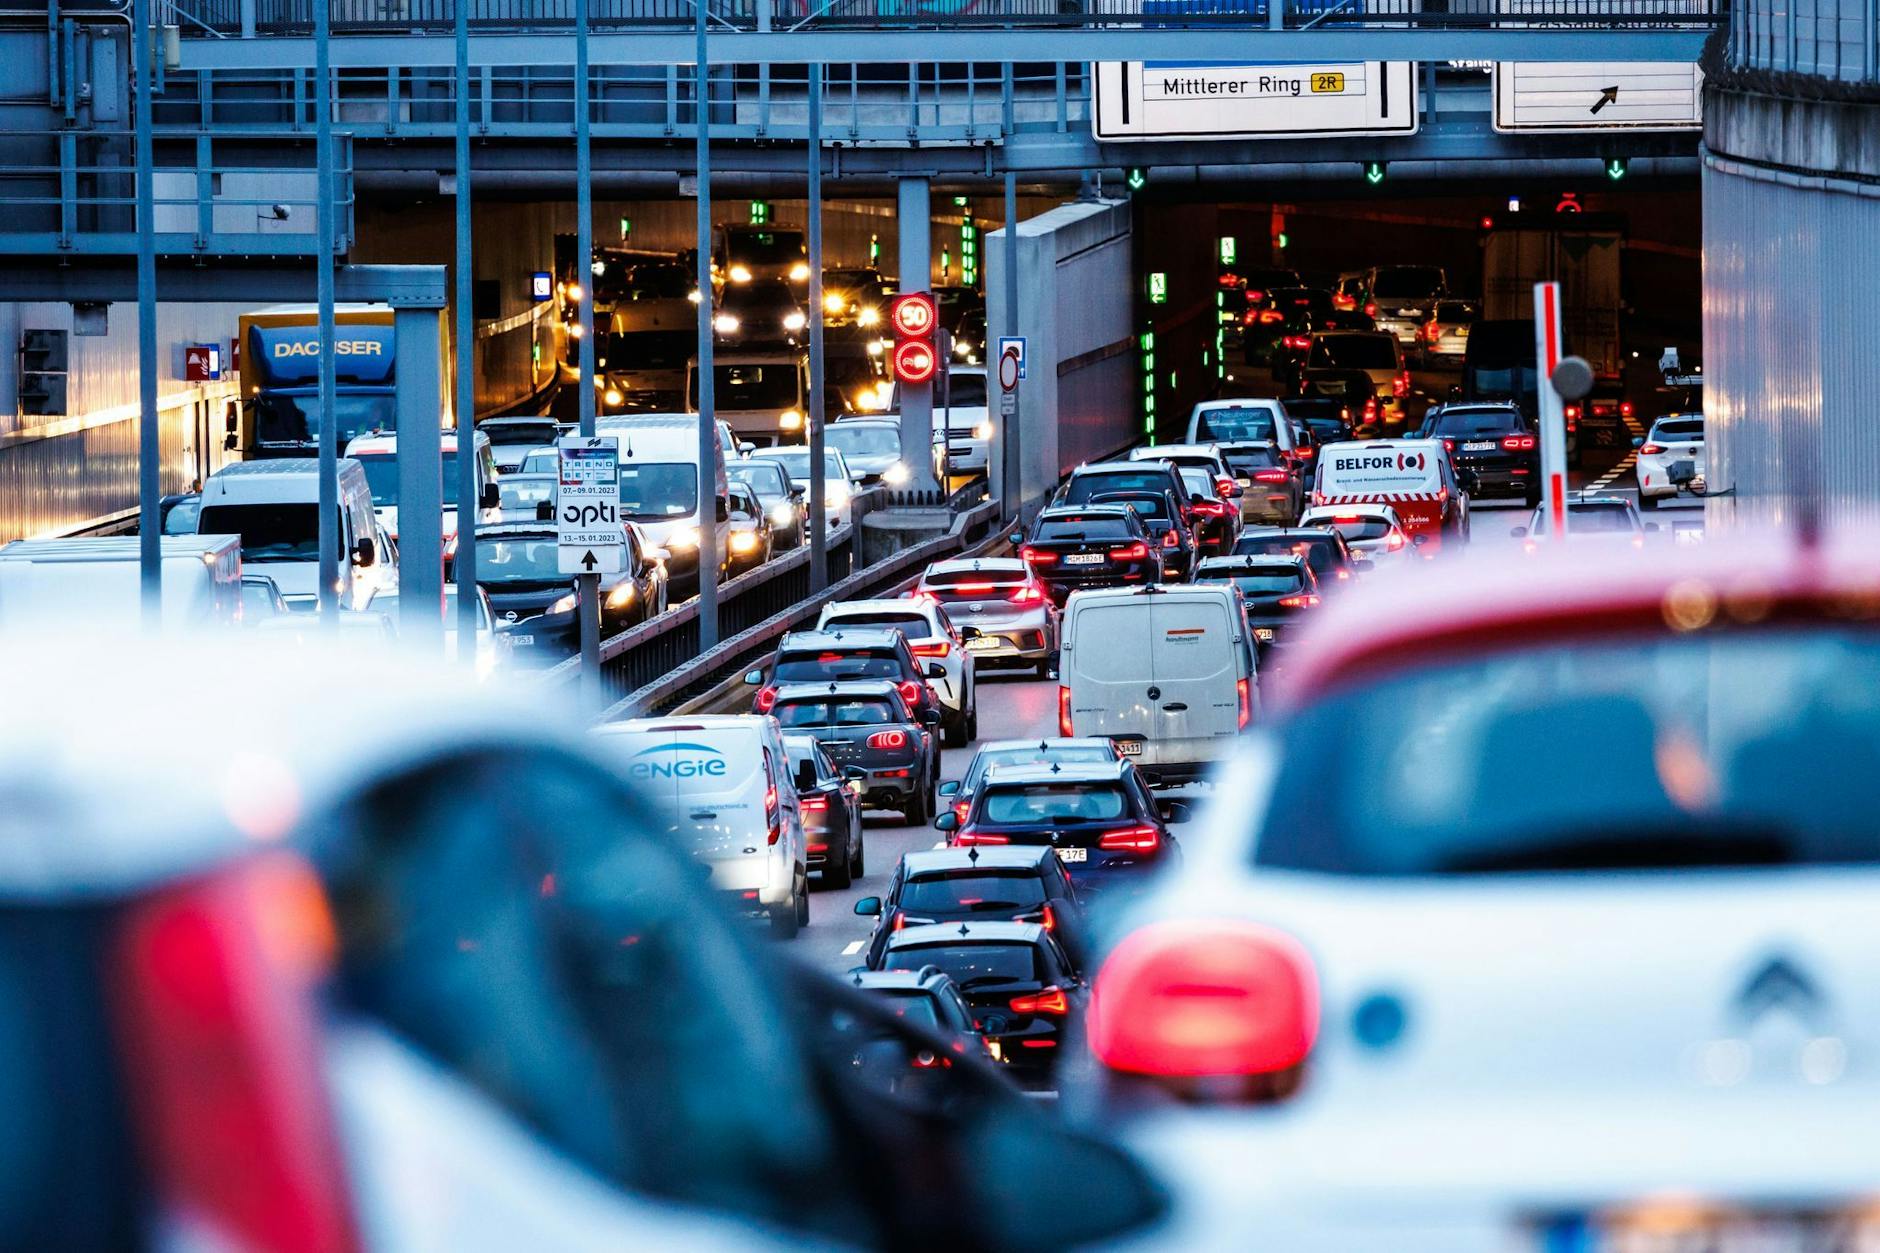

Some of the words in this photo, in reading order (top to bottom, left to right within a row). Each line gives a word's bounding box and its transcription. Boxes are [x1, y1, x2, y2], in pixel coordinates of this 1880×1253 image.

[1164, 78, 1249, 95] Mittlerer
[1259, 76, 1300, 96] Ring
[1318, 76, 1337, 90] 2R
[901, 305, 928, 327] 50
[274, 341, 382, 358] DACSER
[1335, 457, 1393, 471] BELFOR
[563, 501, 615, 527] opti
